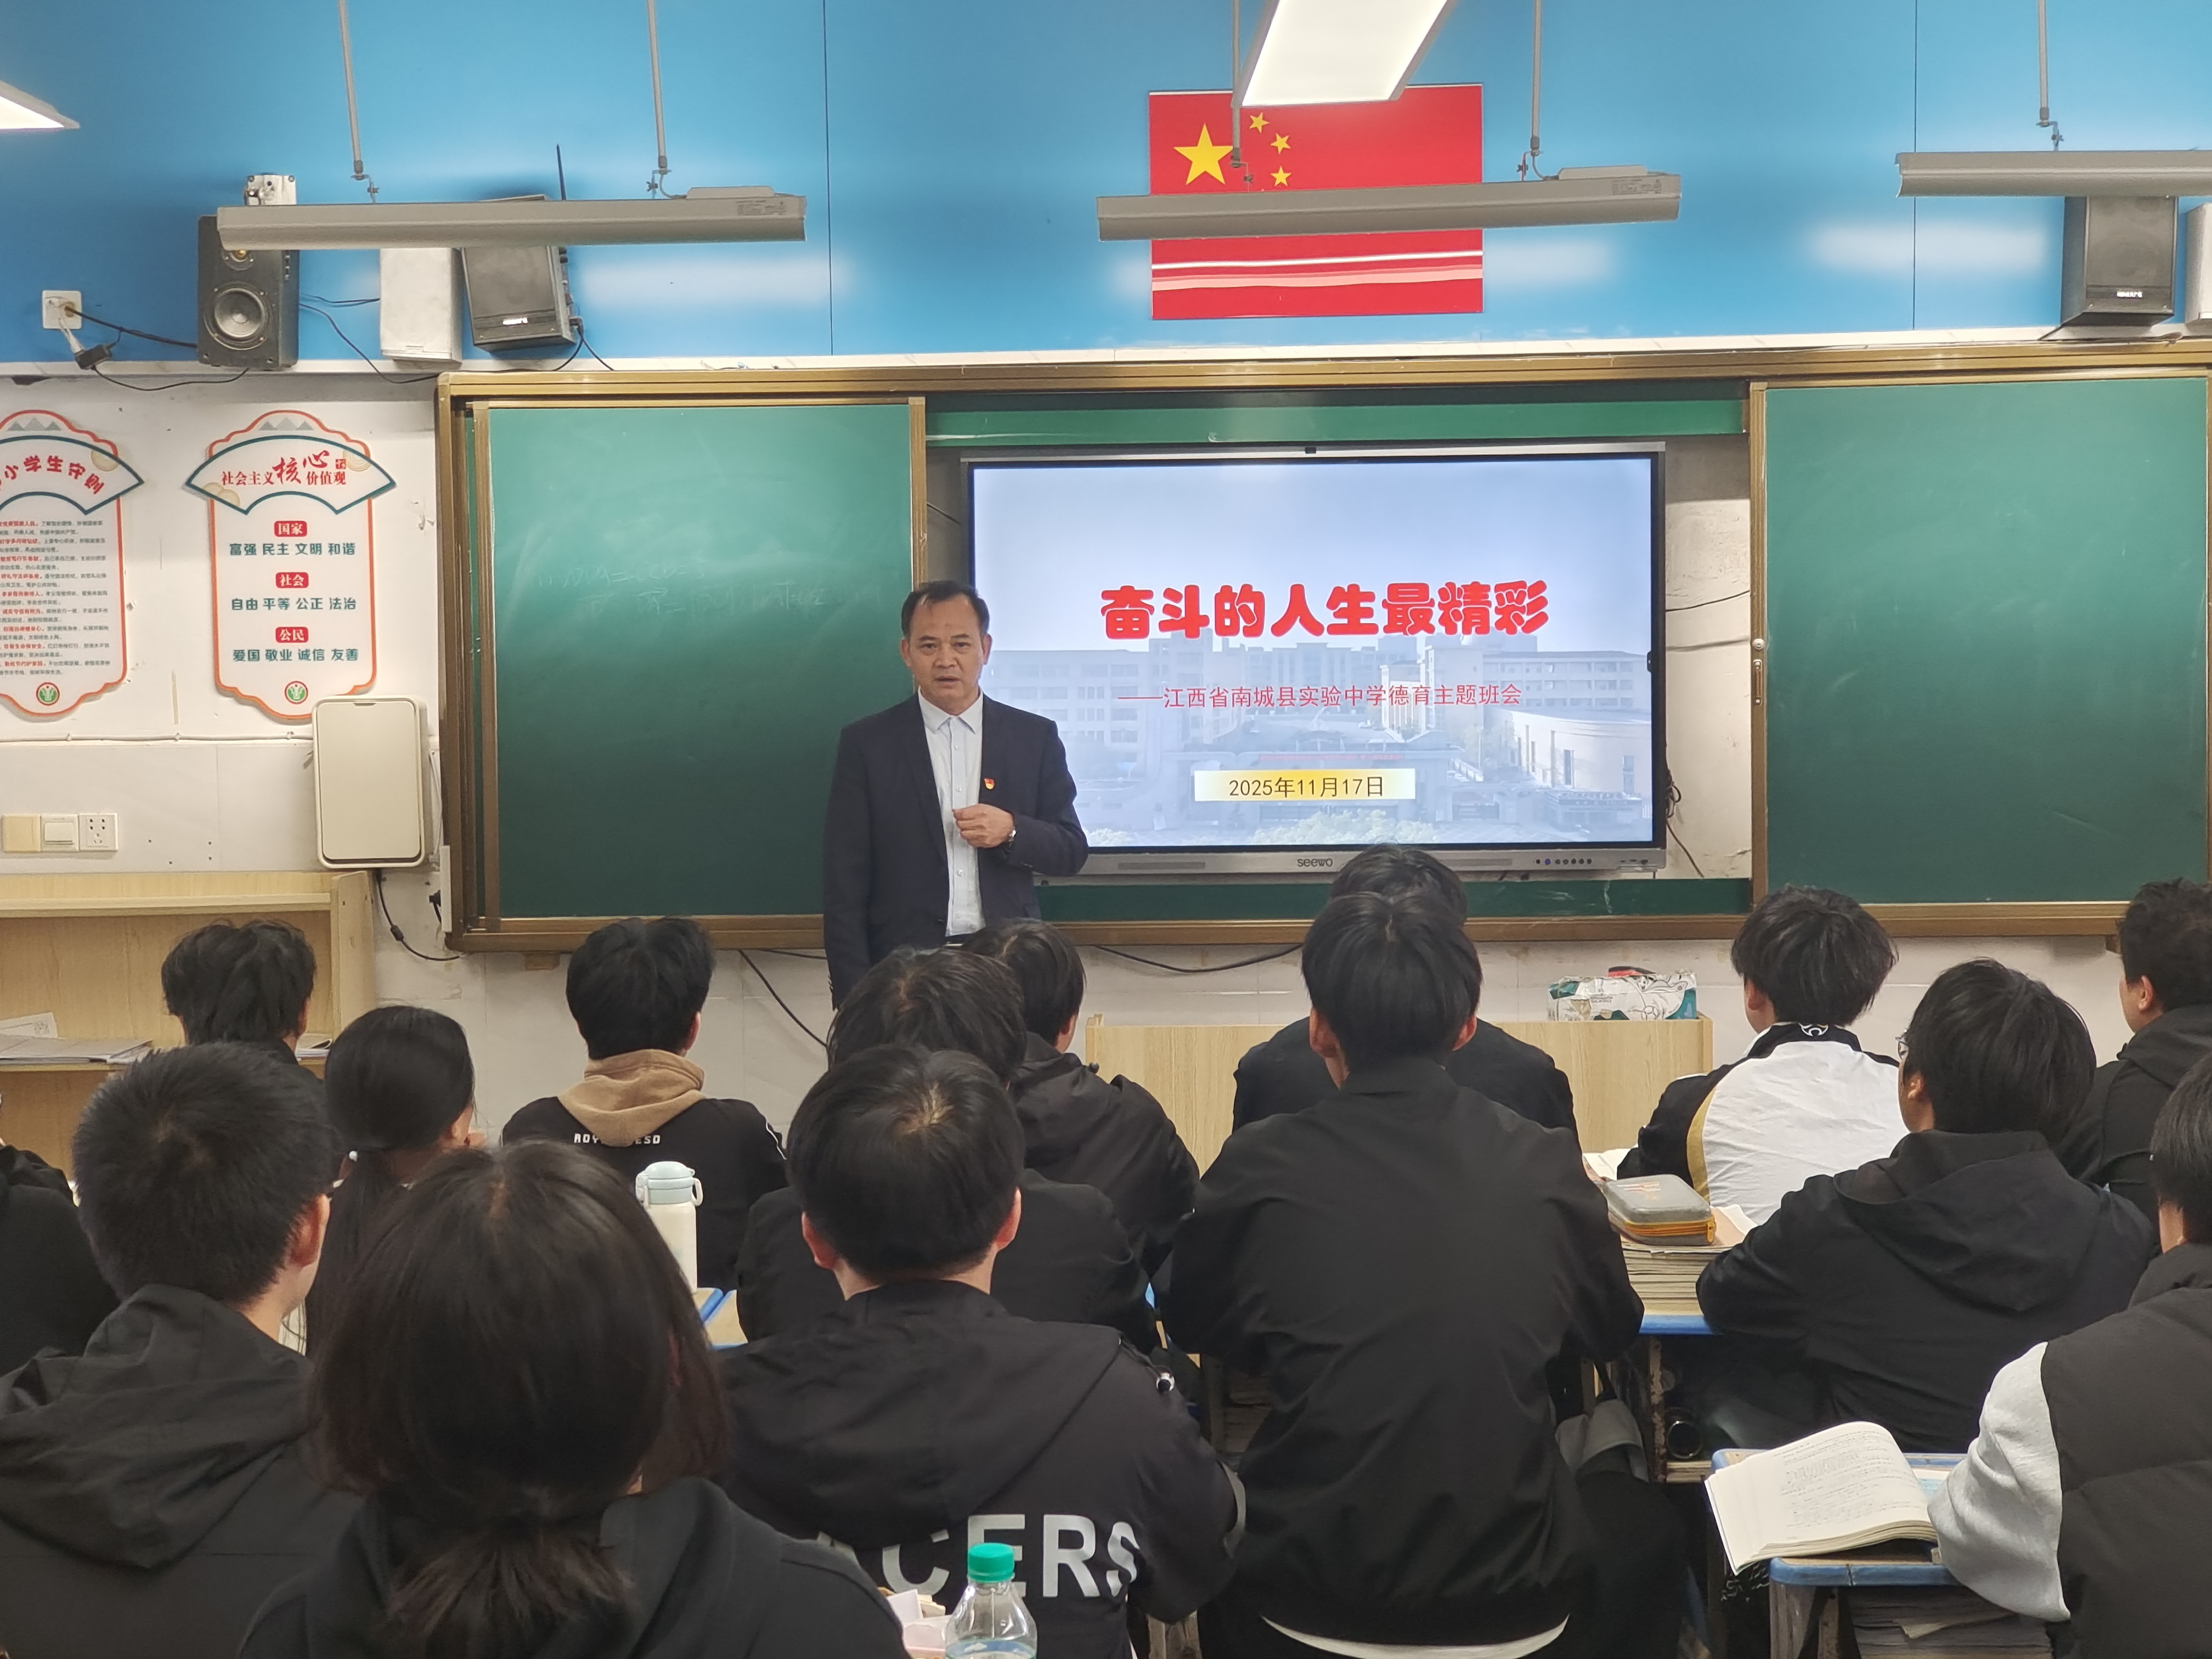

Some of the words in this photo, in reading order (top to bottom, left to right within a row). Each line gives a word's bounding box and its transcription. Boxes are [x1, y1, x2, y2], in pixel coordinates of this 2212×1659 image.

[0, 455, 105, 495] 小学生守则
[278, 522, 303, 536] 国家
[229, 543, 257, 556] 富强
[262, 543, 290, 556] 民主
[295, 542, 323, 556] 文明
[328, 542, 356, 556] 和谐
[280, 573, 305, 587] 社会
[231, 598, 258, 611] 自由
[263, 597, 291, 611] 平等
[296, 597, 324, 611] 公正
[329, 597, 357, 611] 法治
[1100, 579, 1550, 640] 奋斗的人生最精彩
[280, 628, 305, 642] 公民
[233, 649, 261, 662] 爱国
[265, 648, 293, 662] 敬业
[298, 648, 325, 662] 诚信
[331, 648, 359, 662] 友善
[1229, 776, 1383, 798] 2025年11月17日
[1297, 858, 1333, 867] seewo
